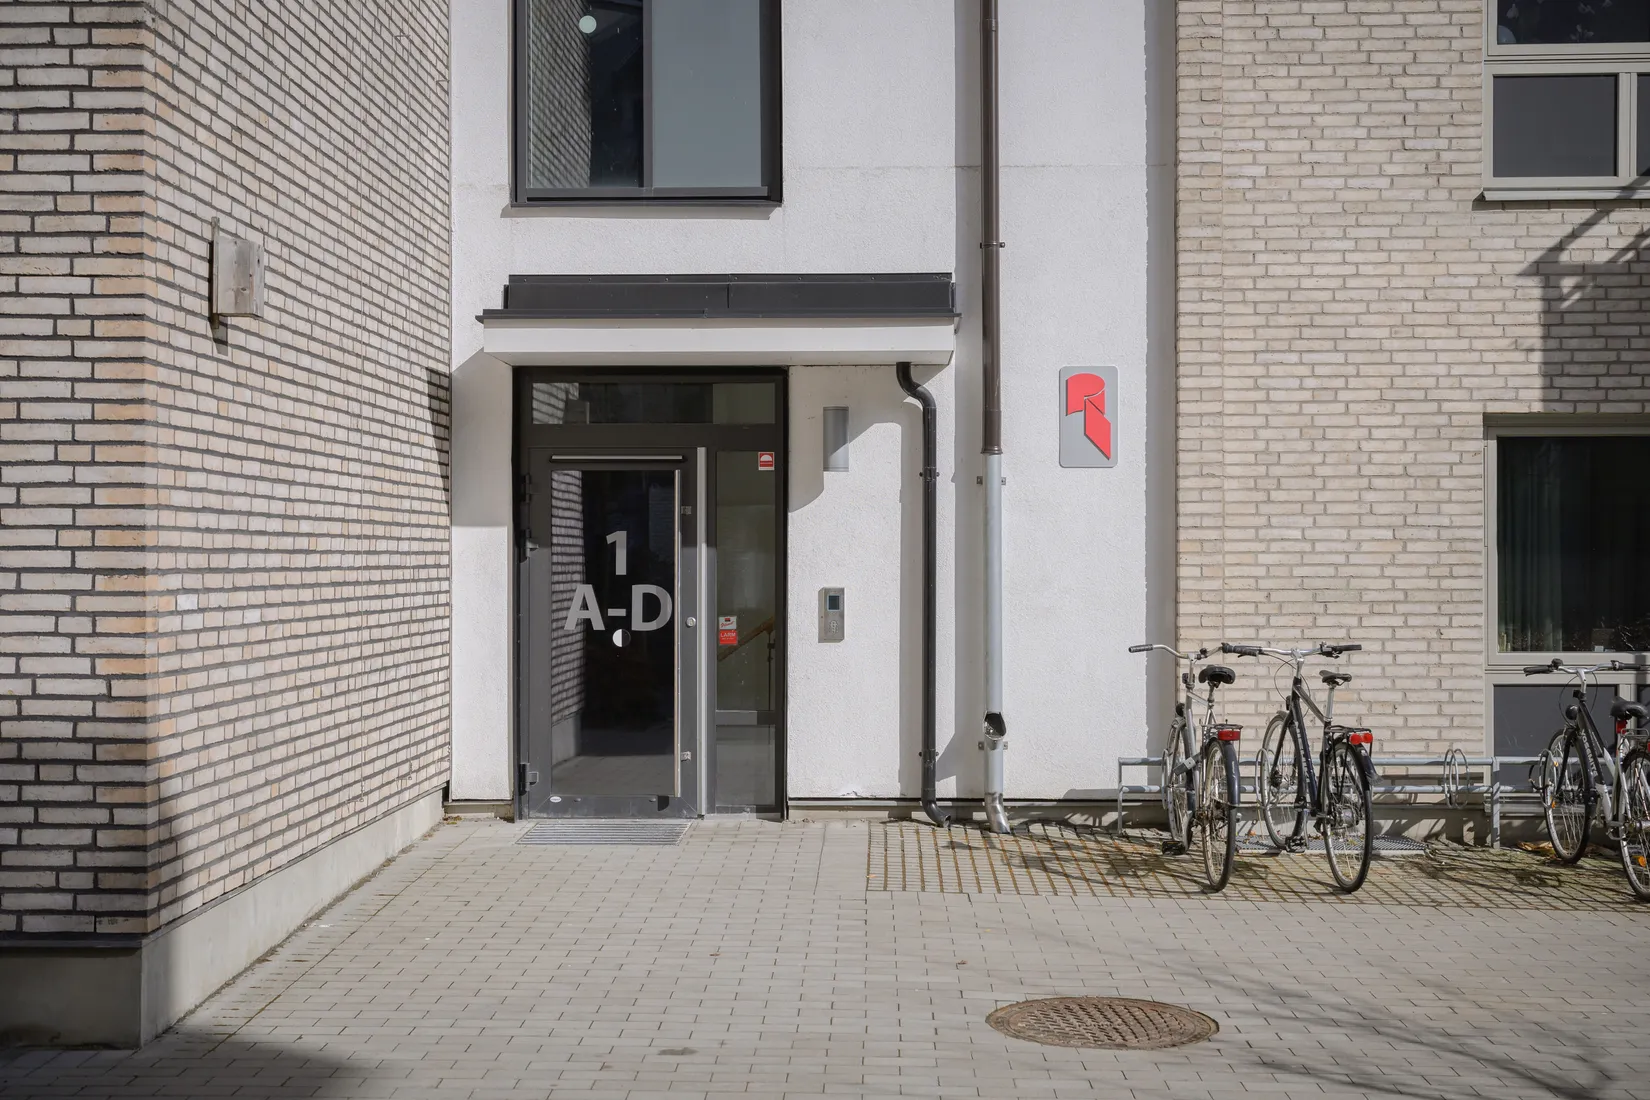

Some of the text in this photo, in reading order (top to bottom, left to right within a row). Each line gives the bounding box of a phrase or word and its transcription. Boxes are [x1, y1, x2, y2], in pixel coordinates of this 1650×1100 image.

[606, 530, 627, 575] 1
[563, 584, 673, 631] A-D
[1580, 729, 1598, 777] YOSEMITE
